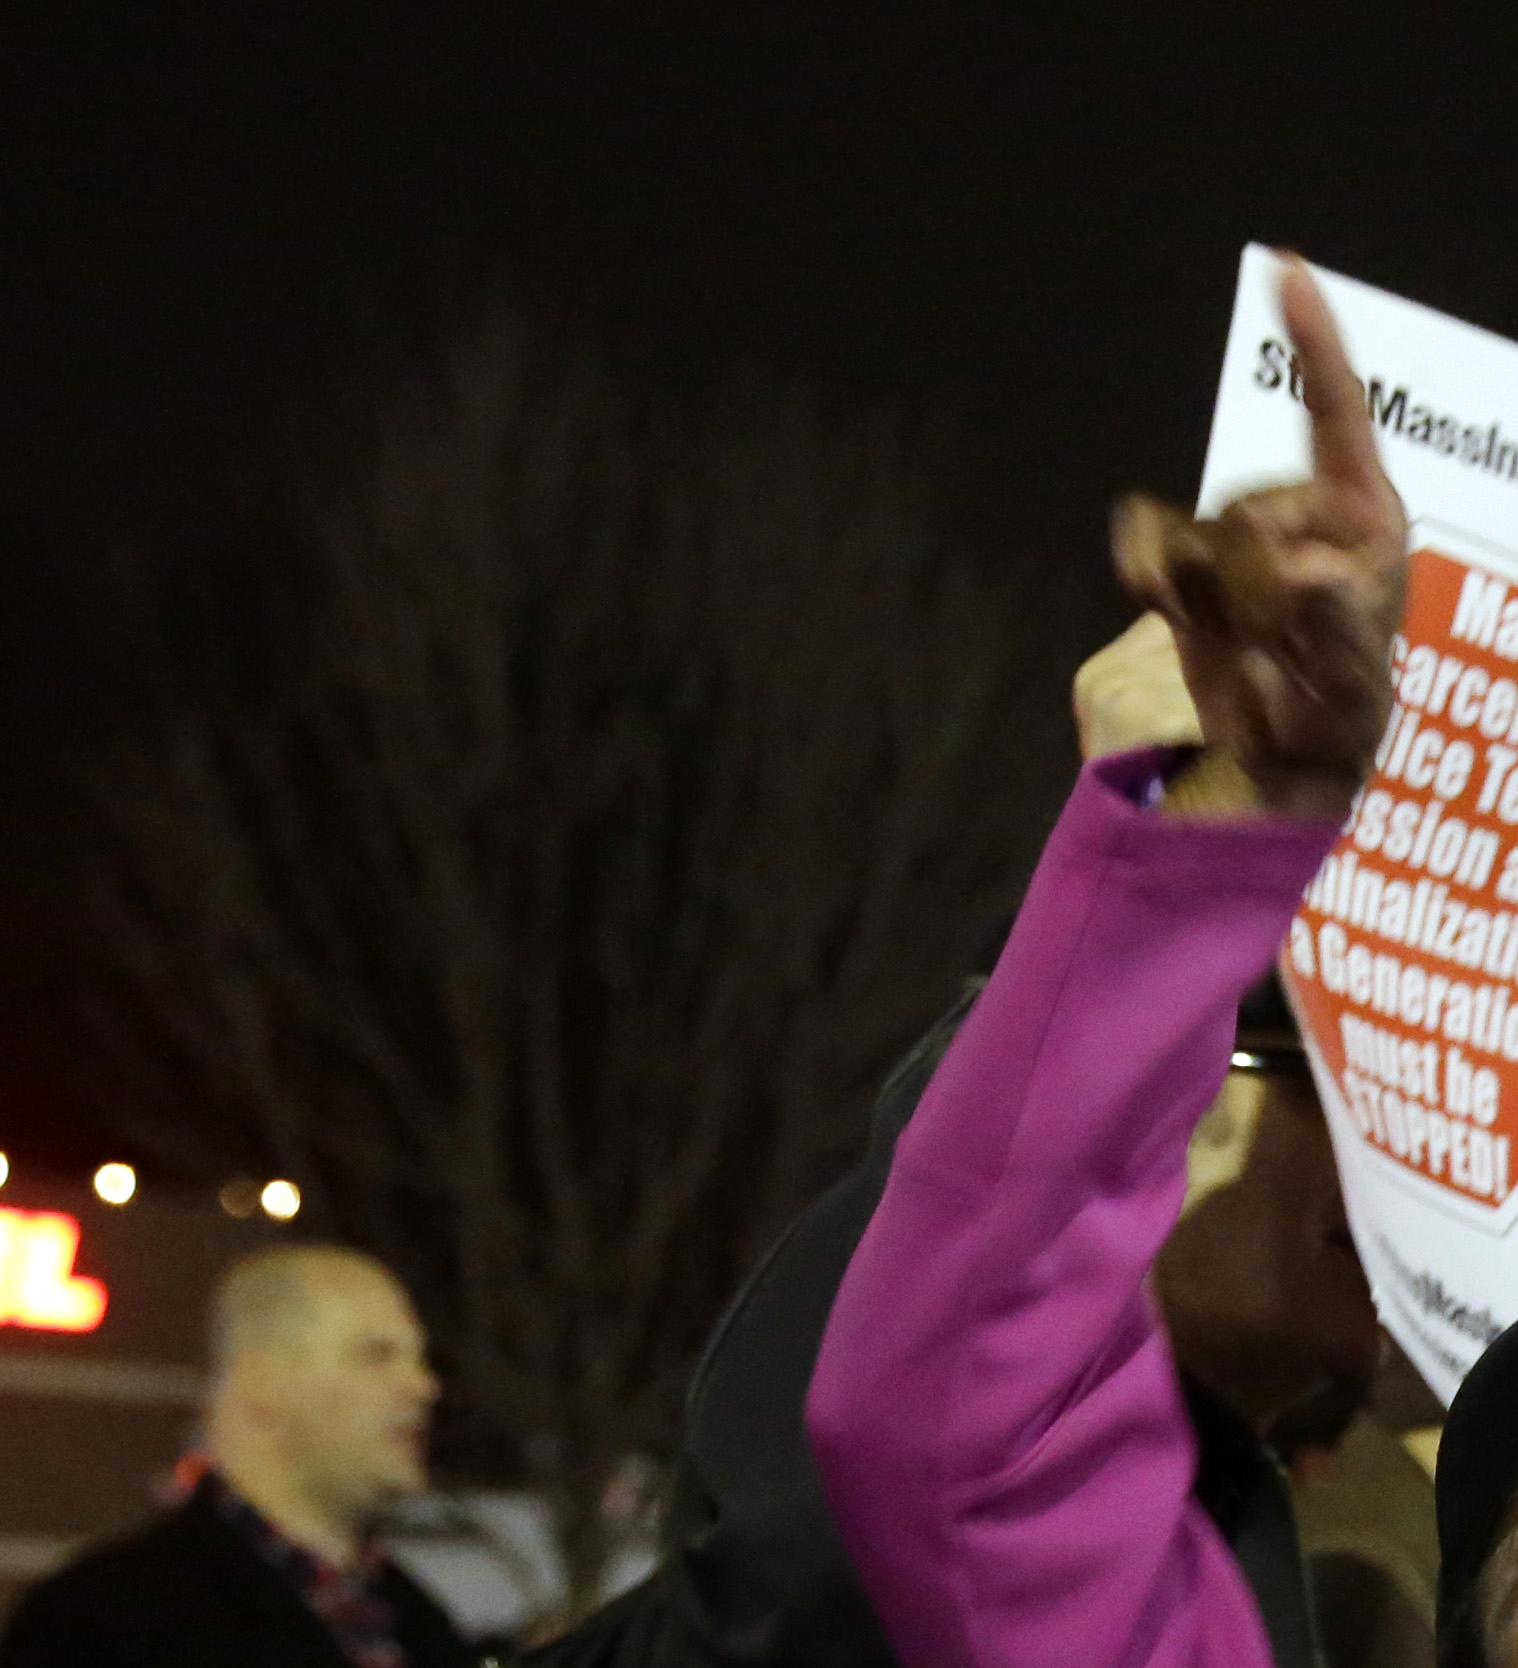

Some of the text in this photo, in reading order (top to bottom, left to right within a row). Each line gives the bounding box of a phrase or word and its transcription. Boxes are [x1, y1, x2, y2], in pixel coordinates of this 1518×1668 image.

[1374, 702, 1475, 800] lice
[1341, 785, 1501, 890] ssion
[1339, 1012, 1500, 1126] must be
